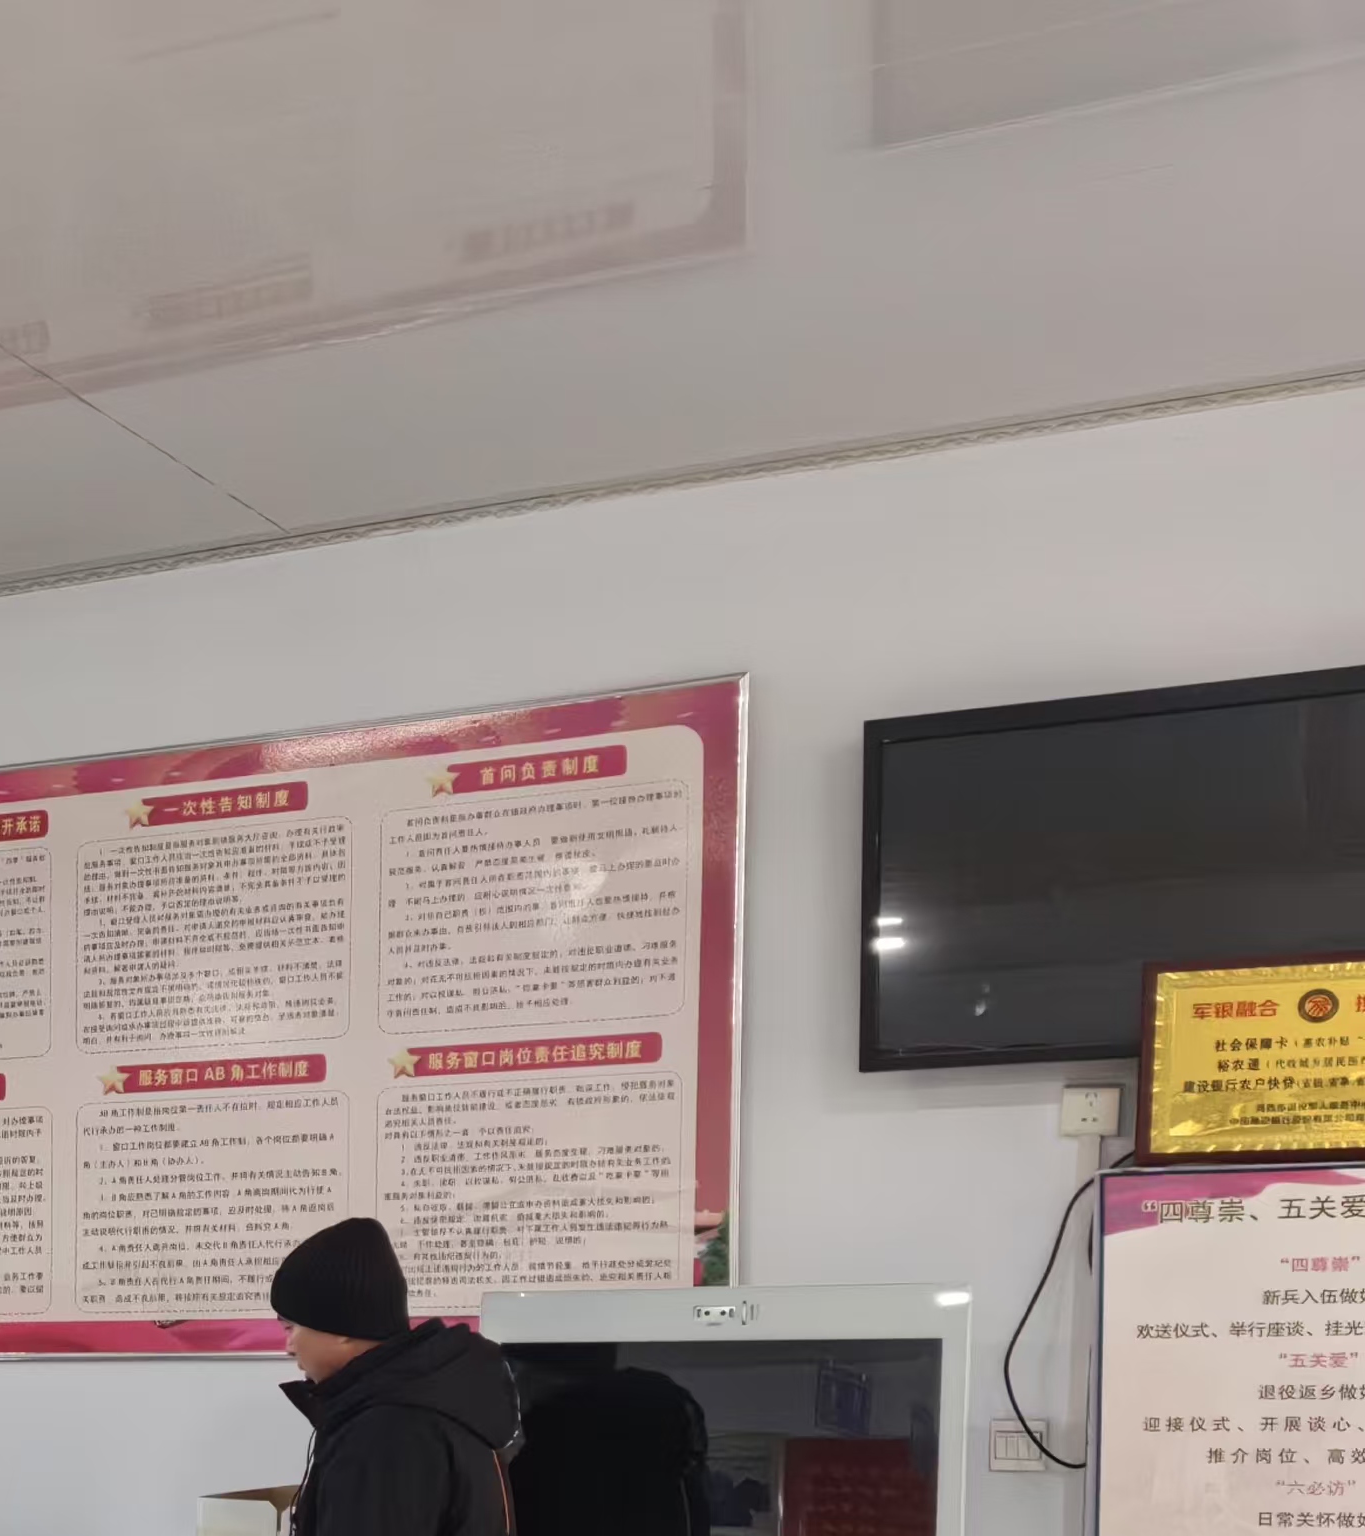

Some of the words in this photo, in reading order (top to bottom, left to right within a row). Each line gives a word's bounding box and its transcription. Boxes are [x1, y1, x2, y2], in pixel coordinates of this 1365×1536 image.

[480, 754, 600, 786] 首问负责制度
[164, 789, 290, 816] 一次性告知制度
[1193, 1000, 1280, 1019] 军银融合
[428, 1040, 642, 1069] 服务窗口岗位责任追究制度
[1280, 1256, 1360, 1273] “四尊崇”
[1279, 1351, 1359, 1369] “五关爱”
[1275, 1480, 1356, 1497] “六必访”
